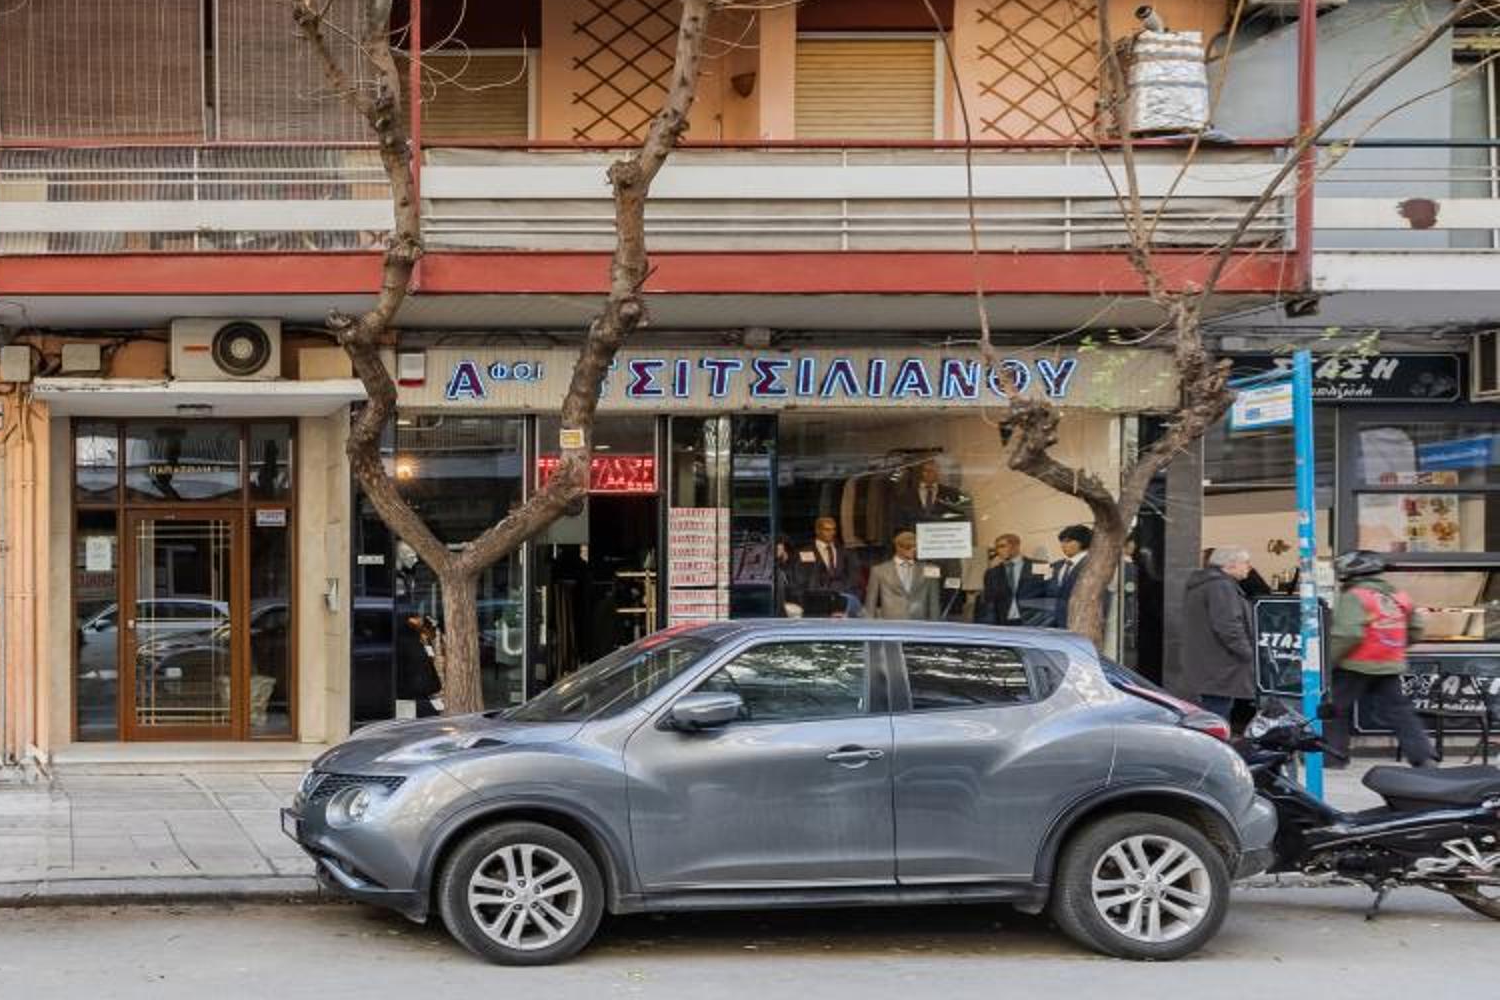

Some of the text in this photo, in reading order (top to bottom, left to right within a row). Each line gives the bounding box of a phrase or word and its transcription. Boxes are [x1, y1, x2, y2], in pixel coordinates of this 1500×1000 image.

[600, 357, 1078, 399] ΣΙΤΣΙΛΙΑΝΟΥ
[1272, 357, 1399, 380] ΣΑΣΗ
[1258, 632, 1303, 650] ΣΤΑΣ
